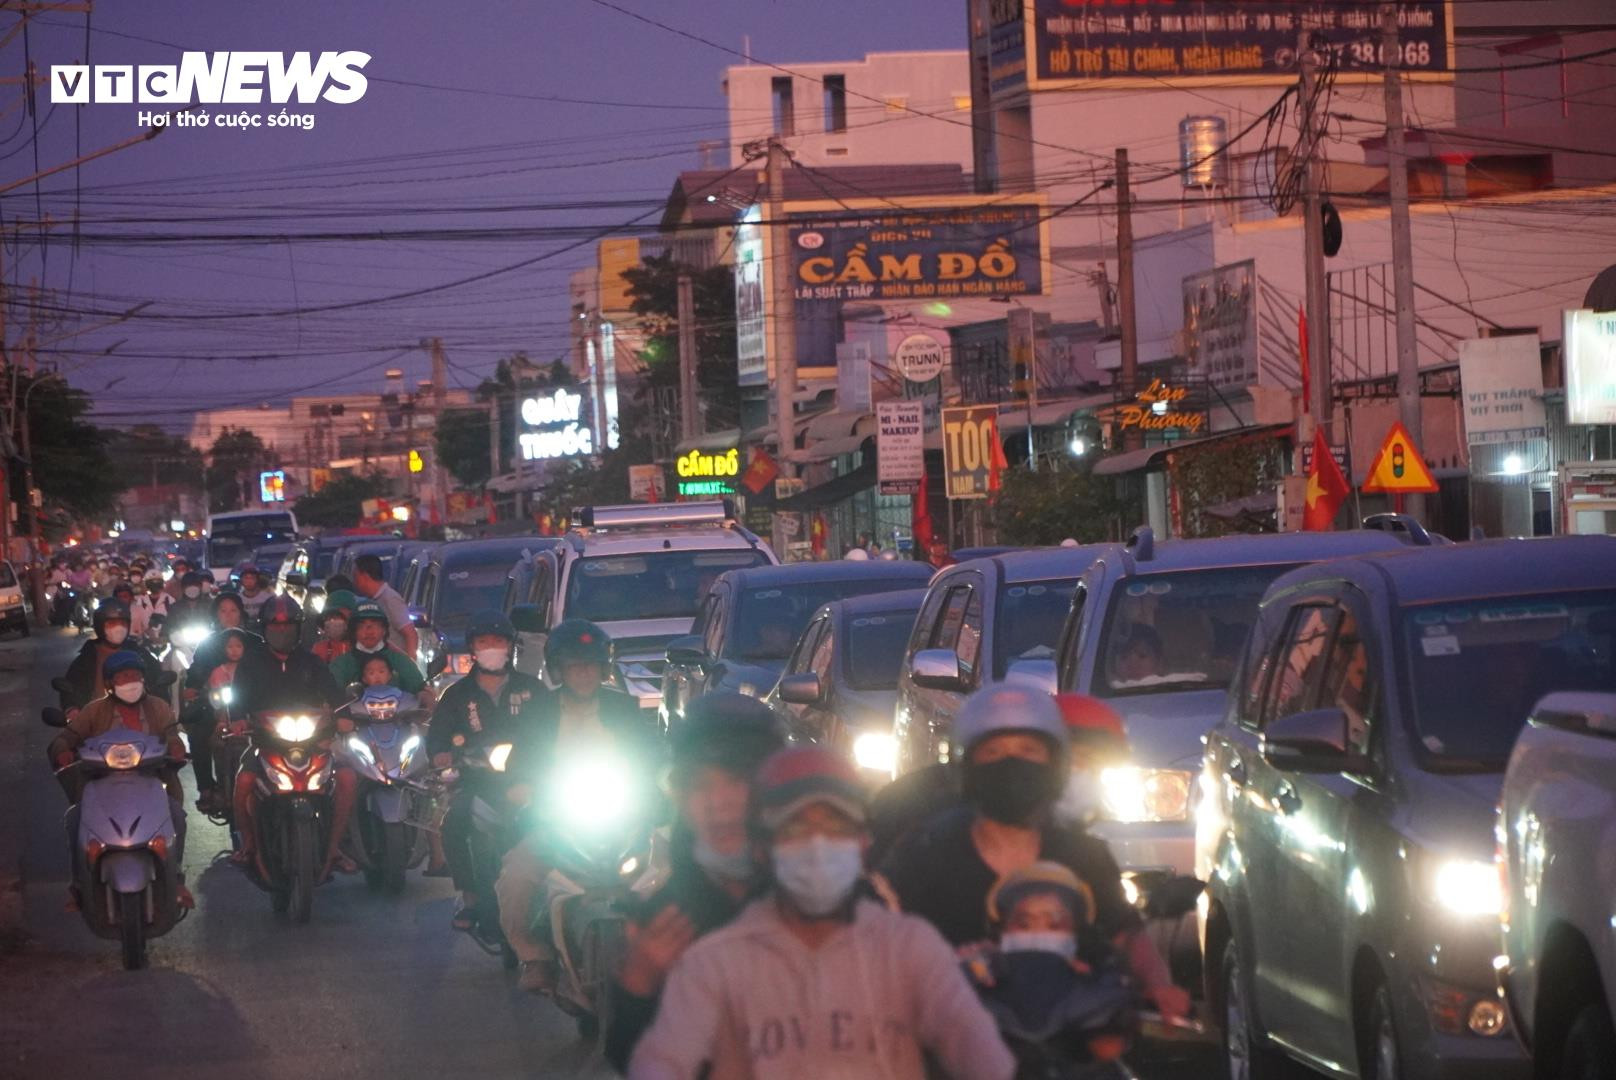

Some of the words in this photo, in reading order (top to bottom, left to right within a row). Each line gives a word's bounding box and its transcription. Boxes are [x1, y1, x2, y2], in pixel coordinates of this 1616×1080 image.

[799, 242, 923, 284] CẦM
[937, 237, 1017, 281] ĐỒ
[881, 426, 920, 436] MAKEUP
